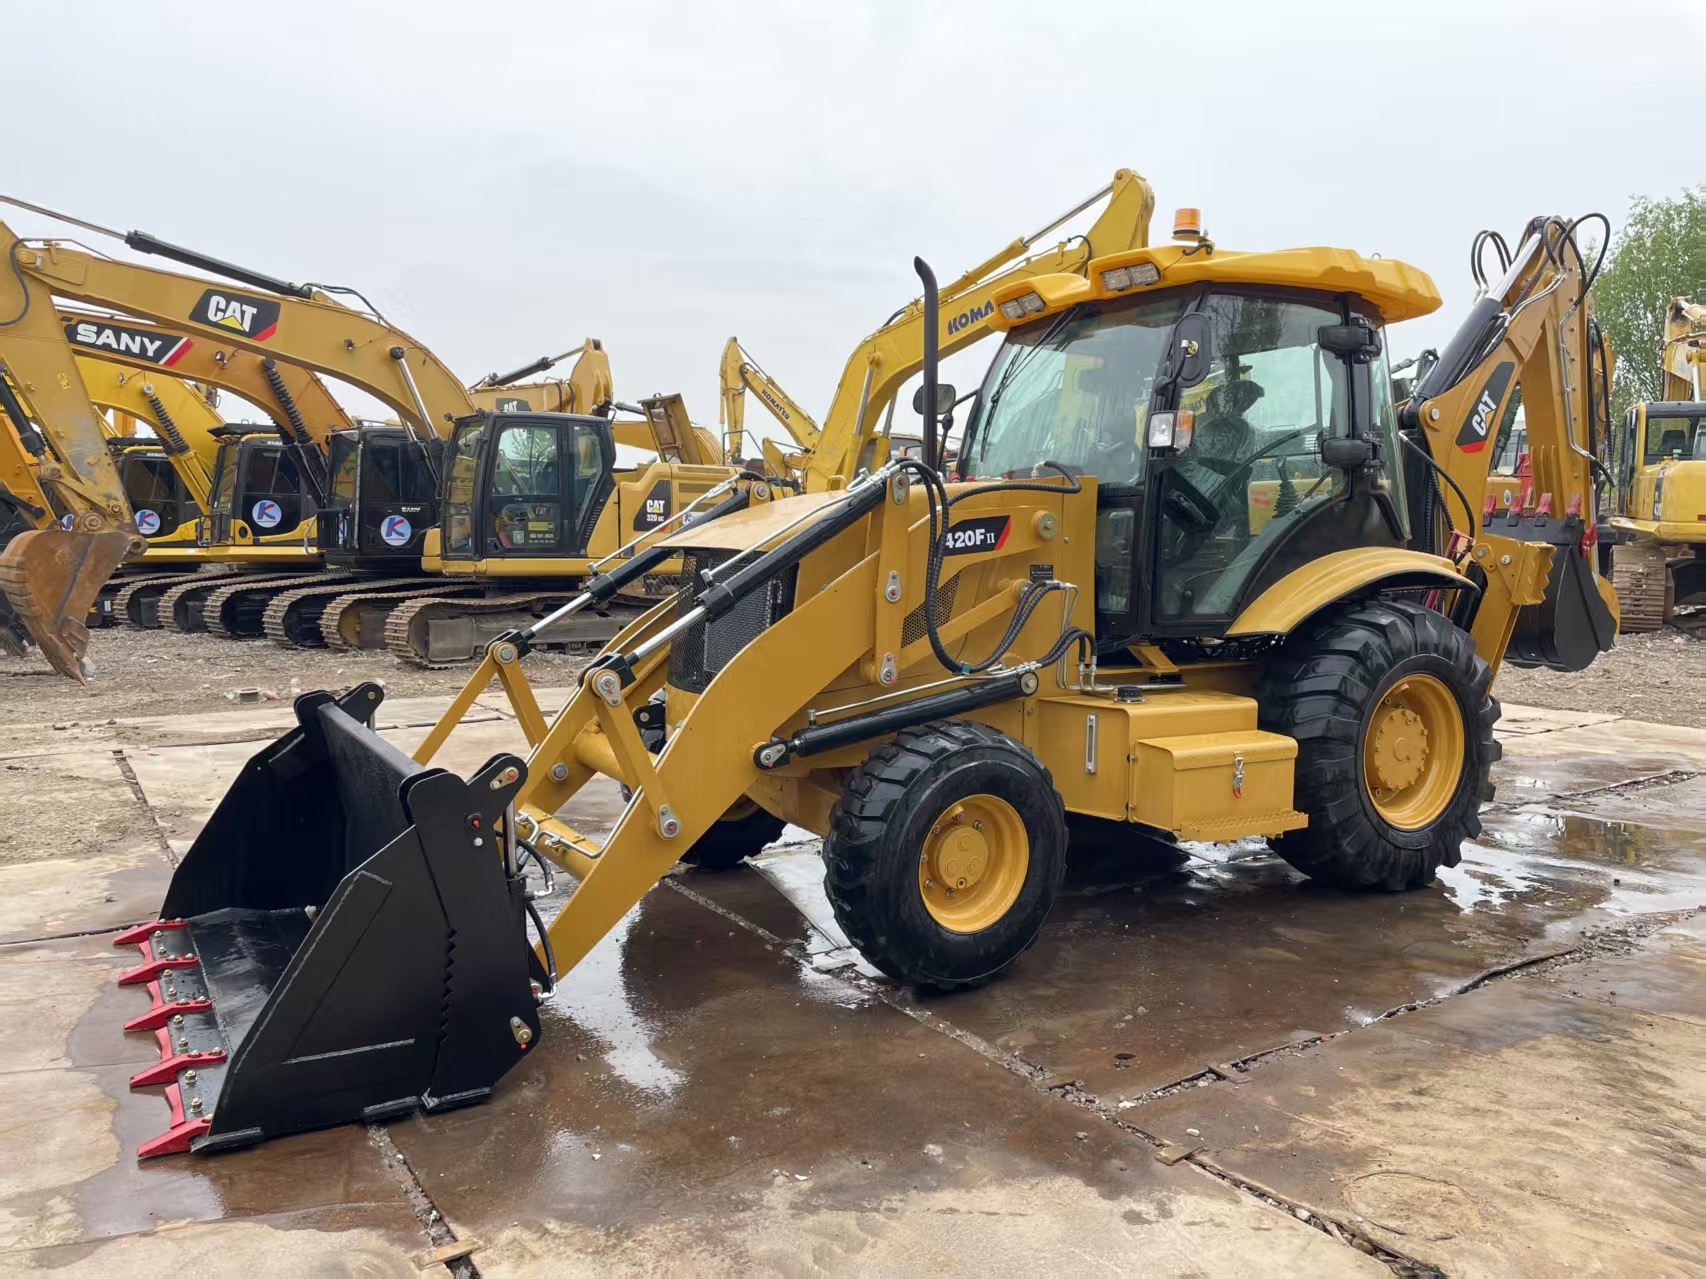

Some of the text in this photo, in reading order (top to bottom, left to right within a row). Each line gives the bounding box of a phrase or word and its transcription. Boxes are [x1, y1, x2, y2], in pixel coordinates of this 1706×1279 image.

[207, 295, 258, 332] CAT
[76, 323, 162, 357] SANY
[761, 388, 790, 420] KOMATSU
[1471, 389, 1497, 436] CAT
[646, 499, 665, 514] CAT
[646, 514, 658, 522] 320
